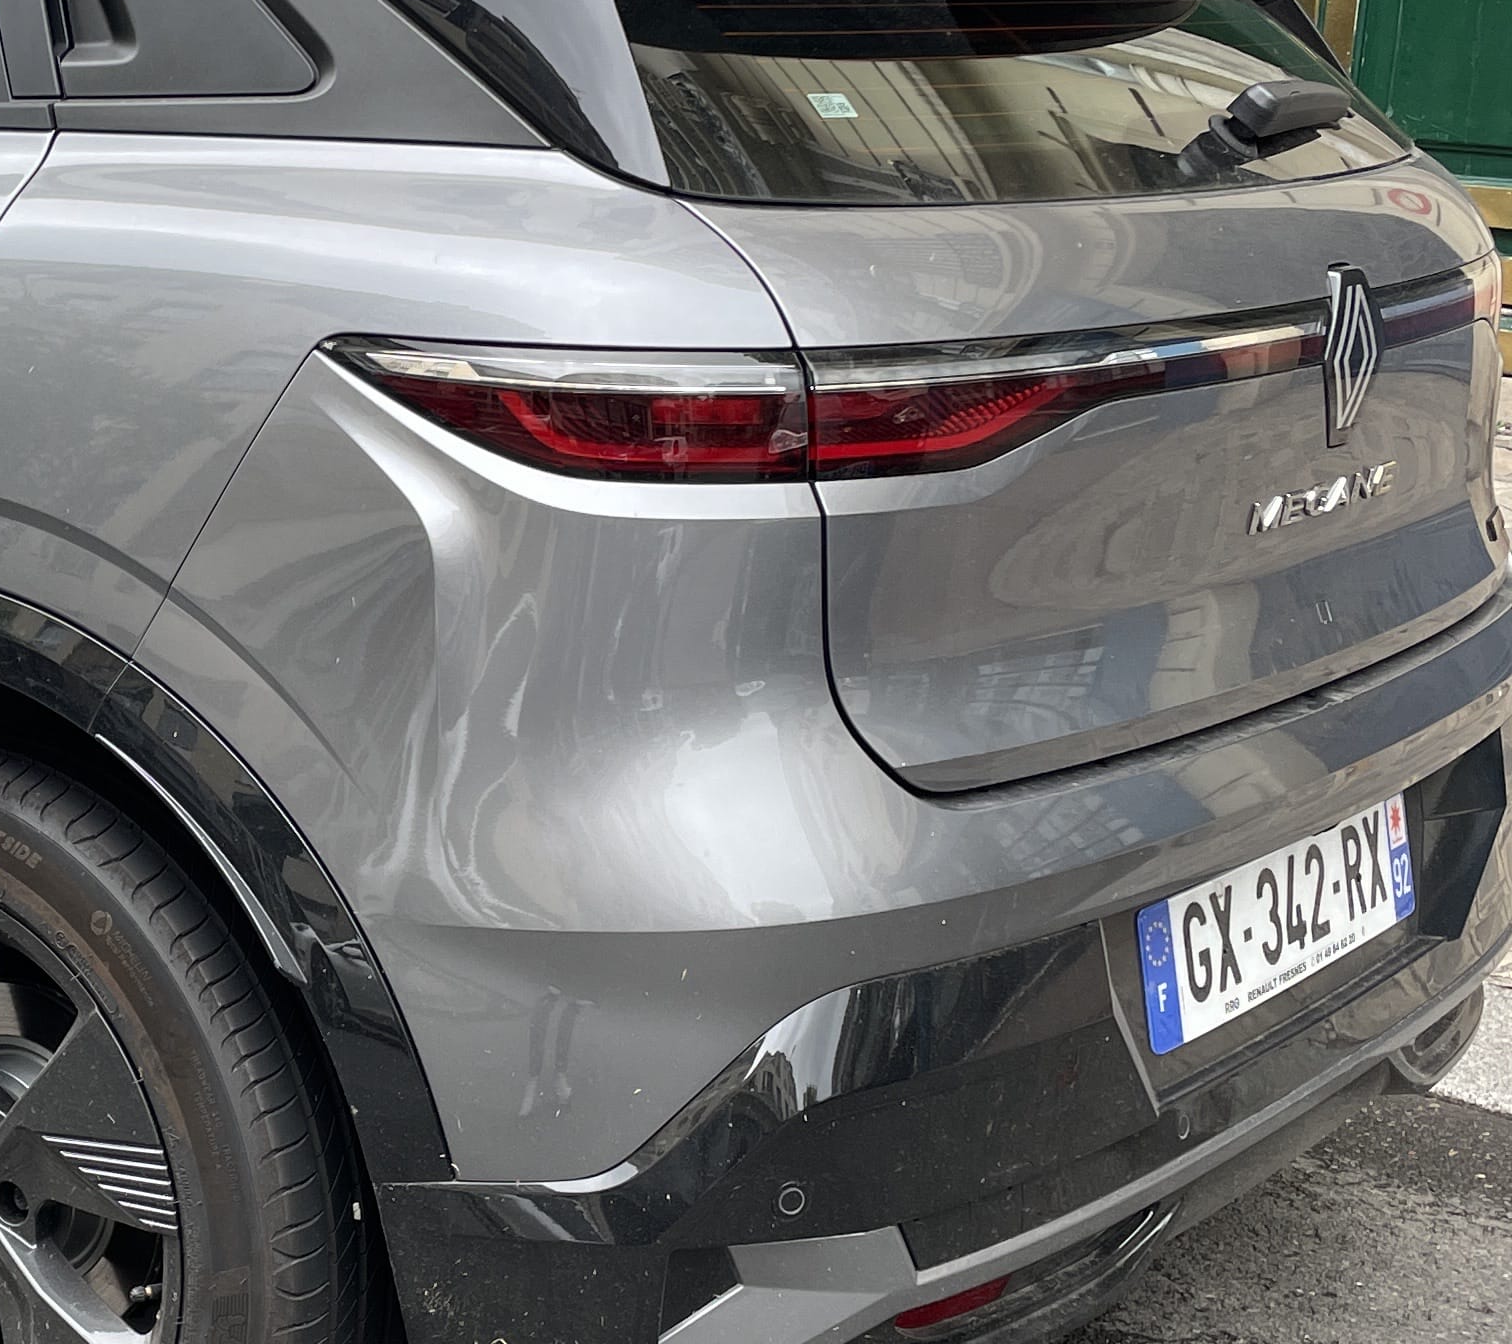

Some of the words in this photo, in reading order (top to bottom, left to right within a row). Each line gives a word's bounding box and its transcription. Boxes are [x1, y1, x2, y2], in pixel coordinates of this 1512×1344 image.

[1392, 853, 1412, 898] 92
[1157, 983, 1169, 1014] F
[1182, 810, 1388, 1004] GX-342-RX
[1247, 976, 1278, 1002] RENAULT
